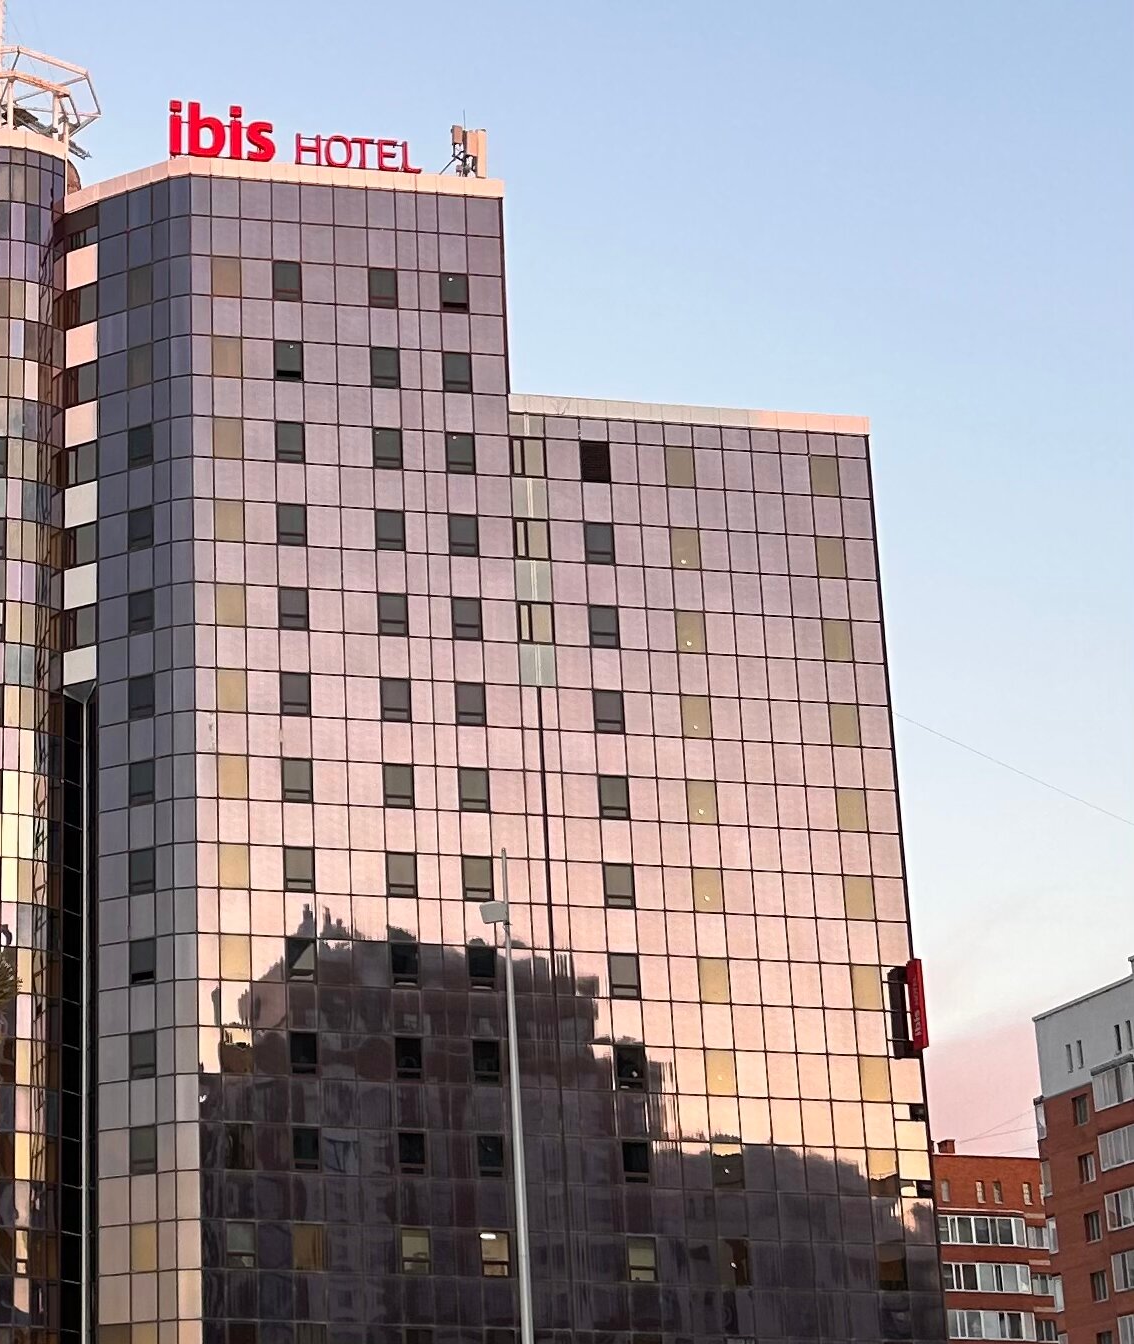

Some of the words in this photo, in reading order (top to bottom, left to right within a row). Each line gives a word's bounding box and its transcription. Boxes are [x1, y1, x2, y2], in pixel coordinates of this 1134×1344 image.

[169, 100, 276, 161] ibis
[295, 133, 422, 173] HOTEL
[913, 1009, 922, 1036] ibis
